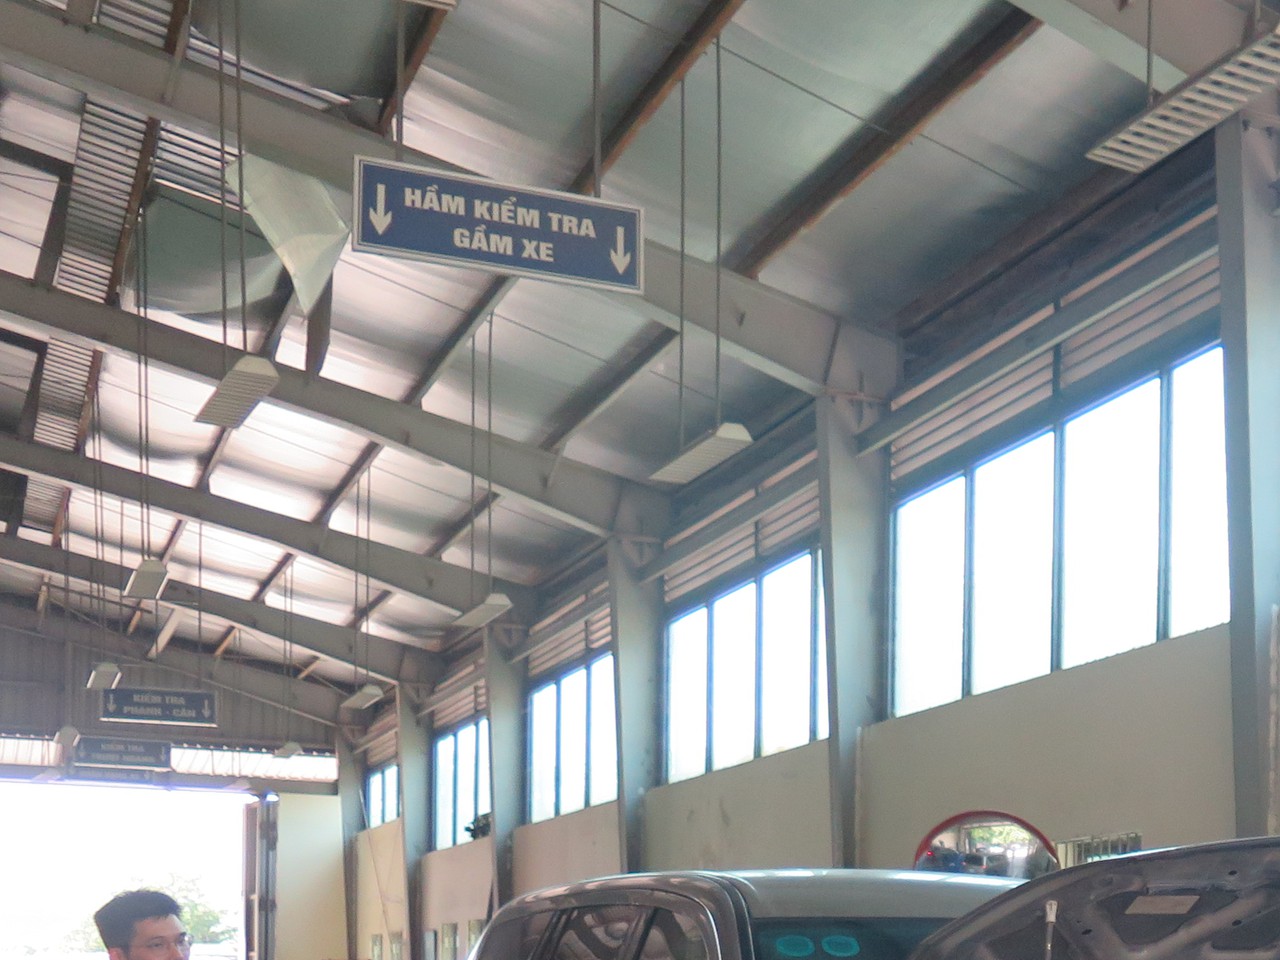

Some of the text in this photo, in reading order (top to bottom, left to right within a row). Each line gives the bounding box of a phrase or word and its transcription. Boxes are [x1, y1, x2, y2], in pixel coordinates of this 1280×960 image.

[404, 184, 597, 239] HẦM KIỂM TRA
[453, 223, 555, 262] GẦM XE
